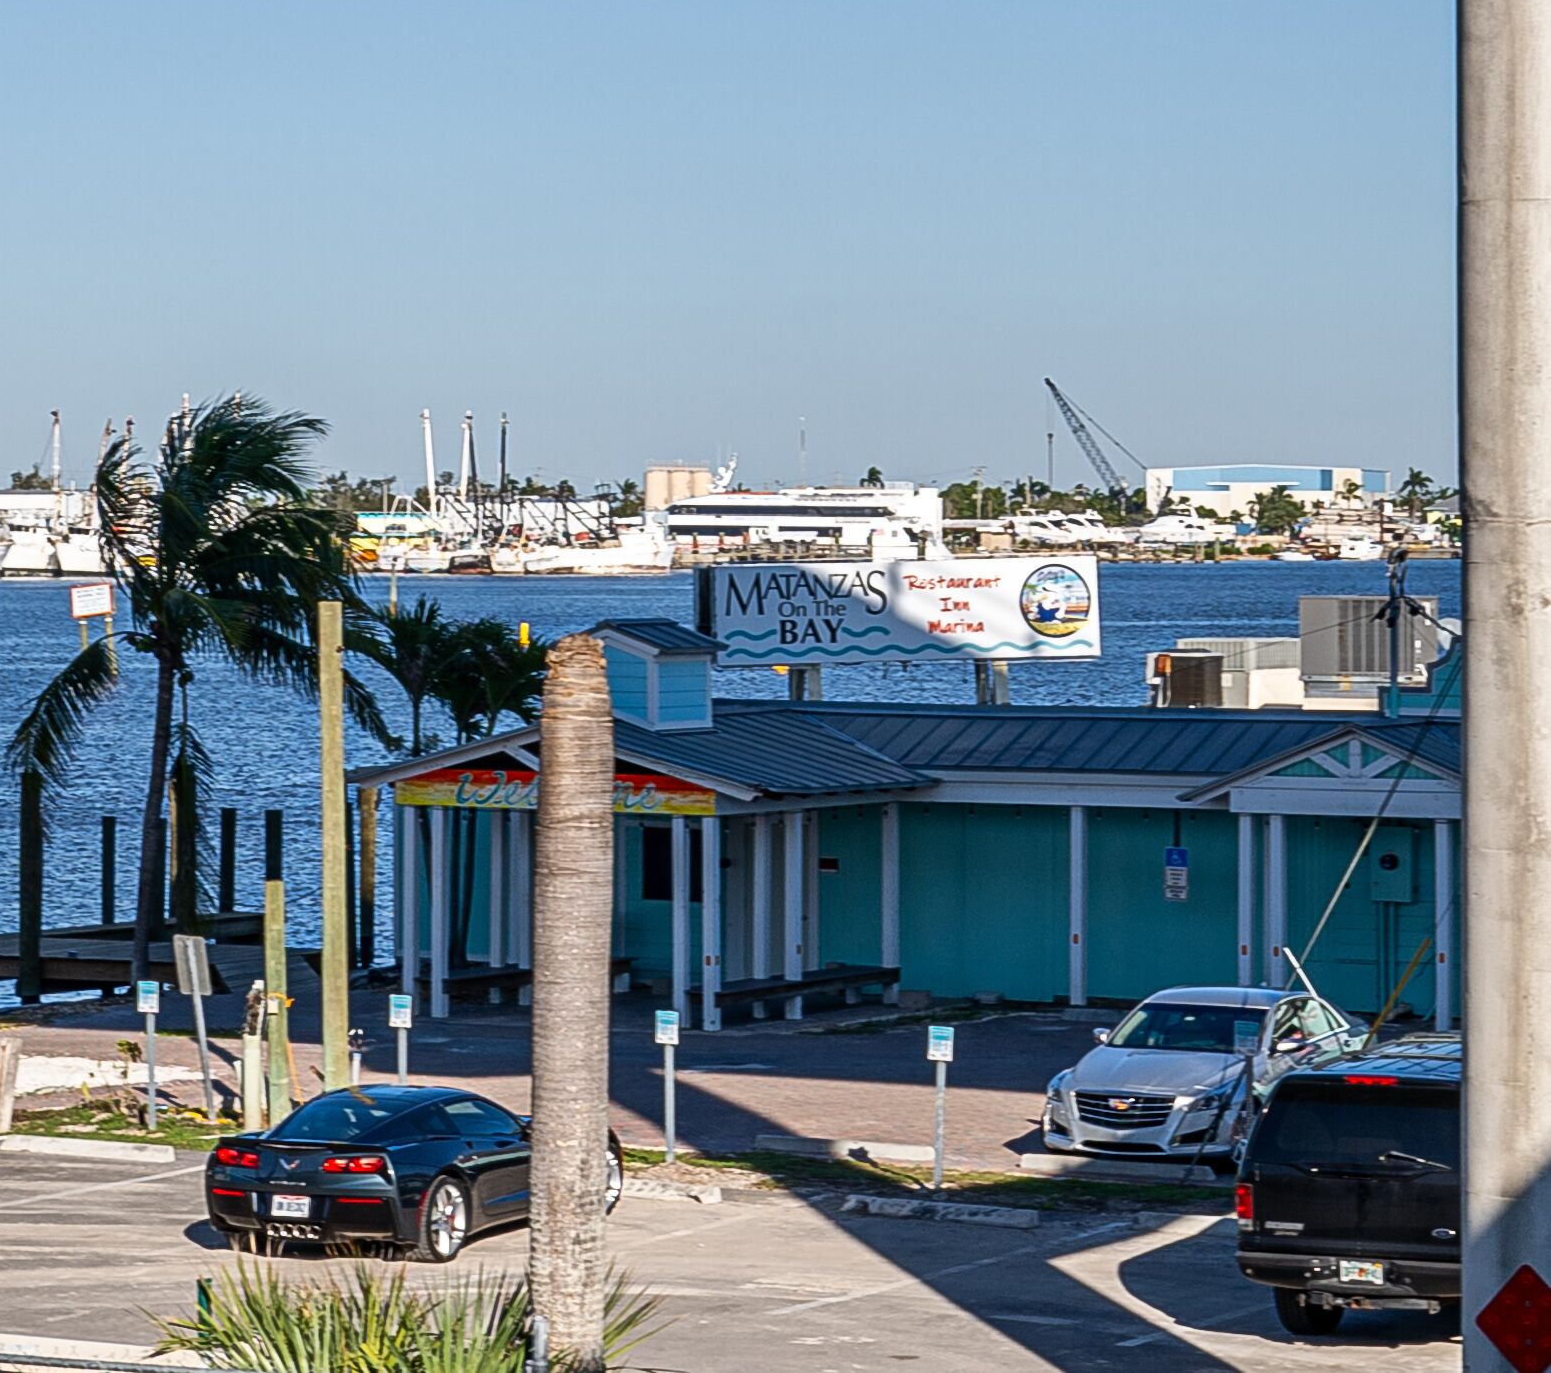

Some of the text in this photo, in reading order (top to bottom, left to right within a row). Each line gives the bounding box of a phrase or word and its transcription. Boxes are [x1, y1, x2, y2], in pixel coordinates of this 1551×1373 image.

[902, 574, 1002, 591] Restaurant
[725, 570, 888, 617] MATANZAS
[777, 599, 847, 618] On The
[938, 596, 971, 612] Inn
[779, 618, 845, 645] BAY
[926, 618, 986, 635] Marina
